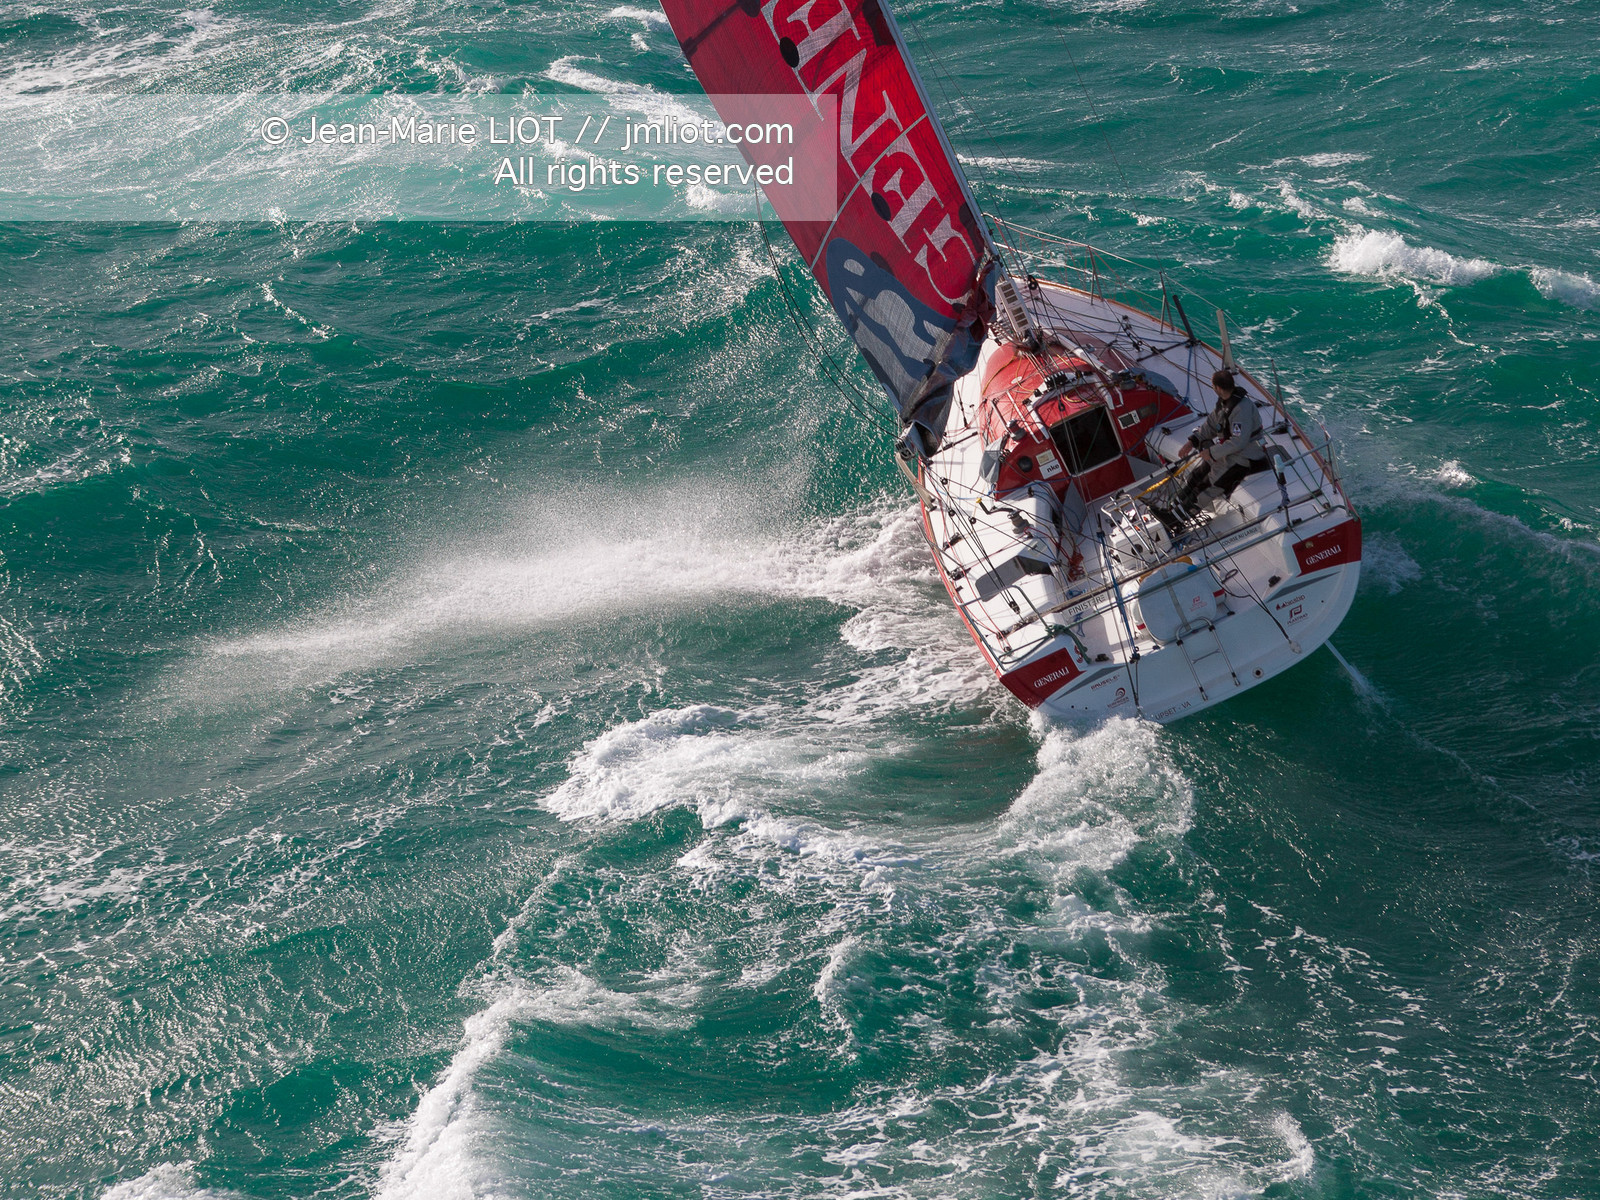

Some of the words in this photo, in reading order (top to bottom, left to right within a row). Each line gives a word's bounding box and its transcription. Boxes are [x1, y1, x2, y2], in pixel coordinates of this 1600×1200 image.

[1046, 464, 1060, 473] nke
[1305, 544, 1342, 566] GENERALI
[1033, 666, 1070, 689] GENERALI
[1155, 706, 1178, 720] UPSET
